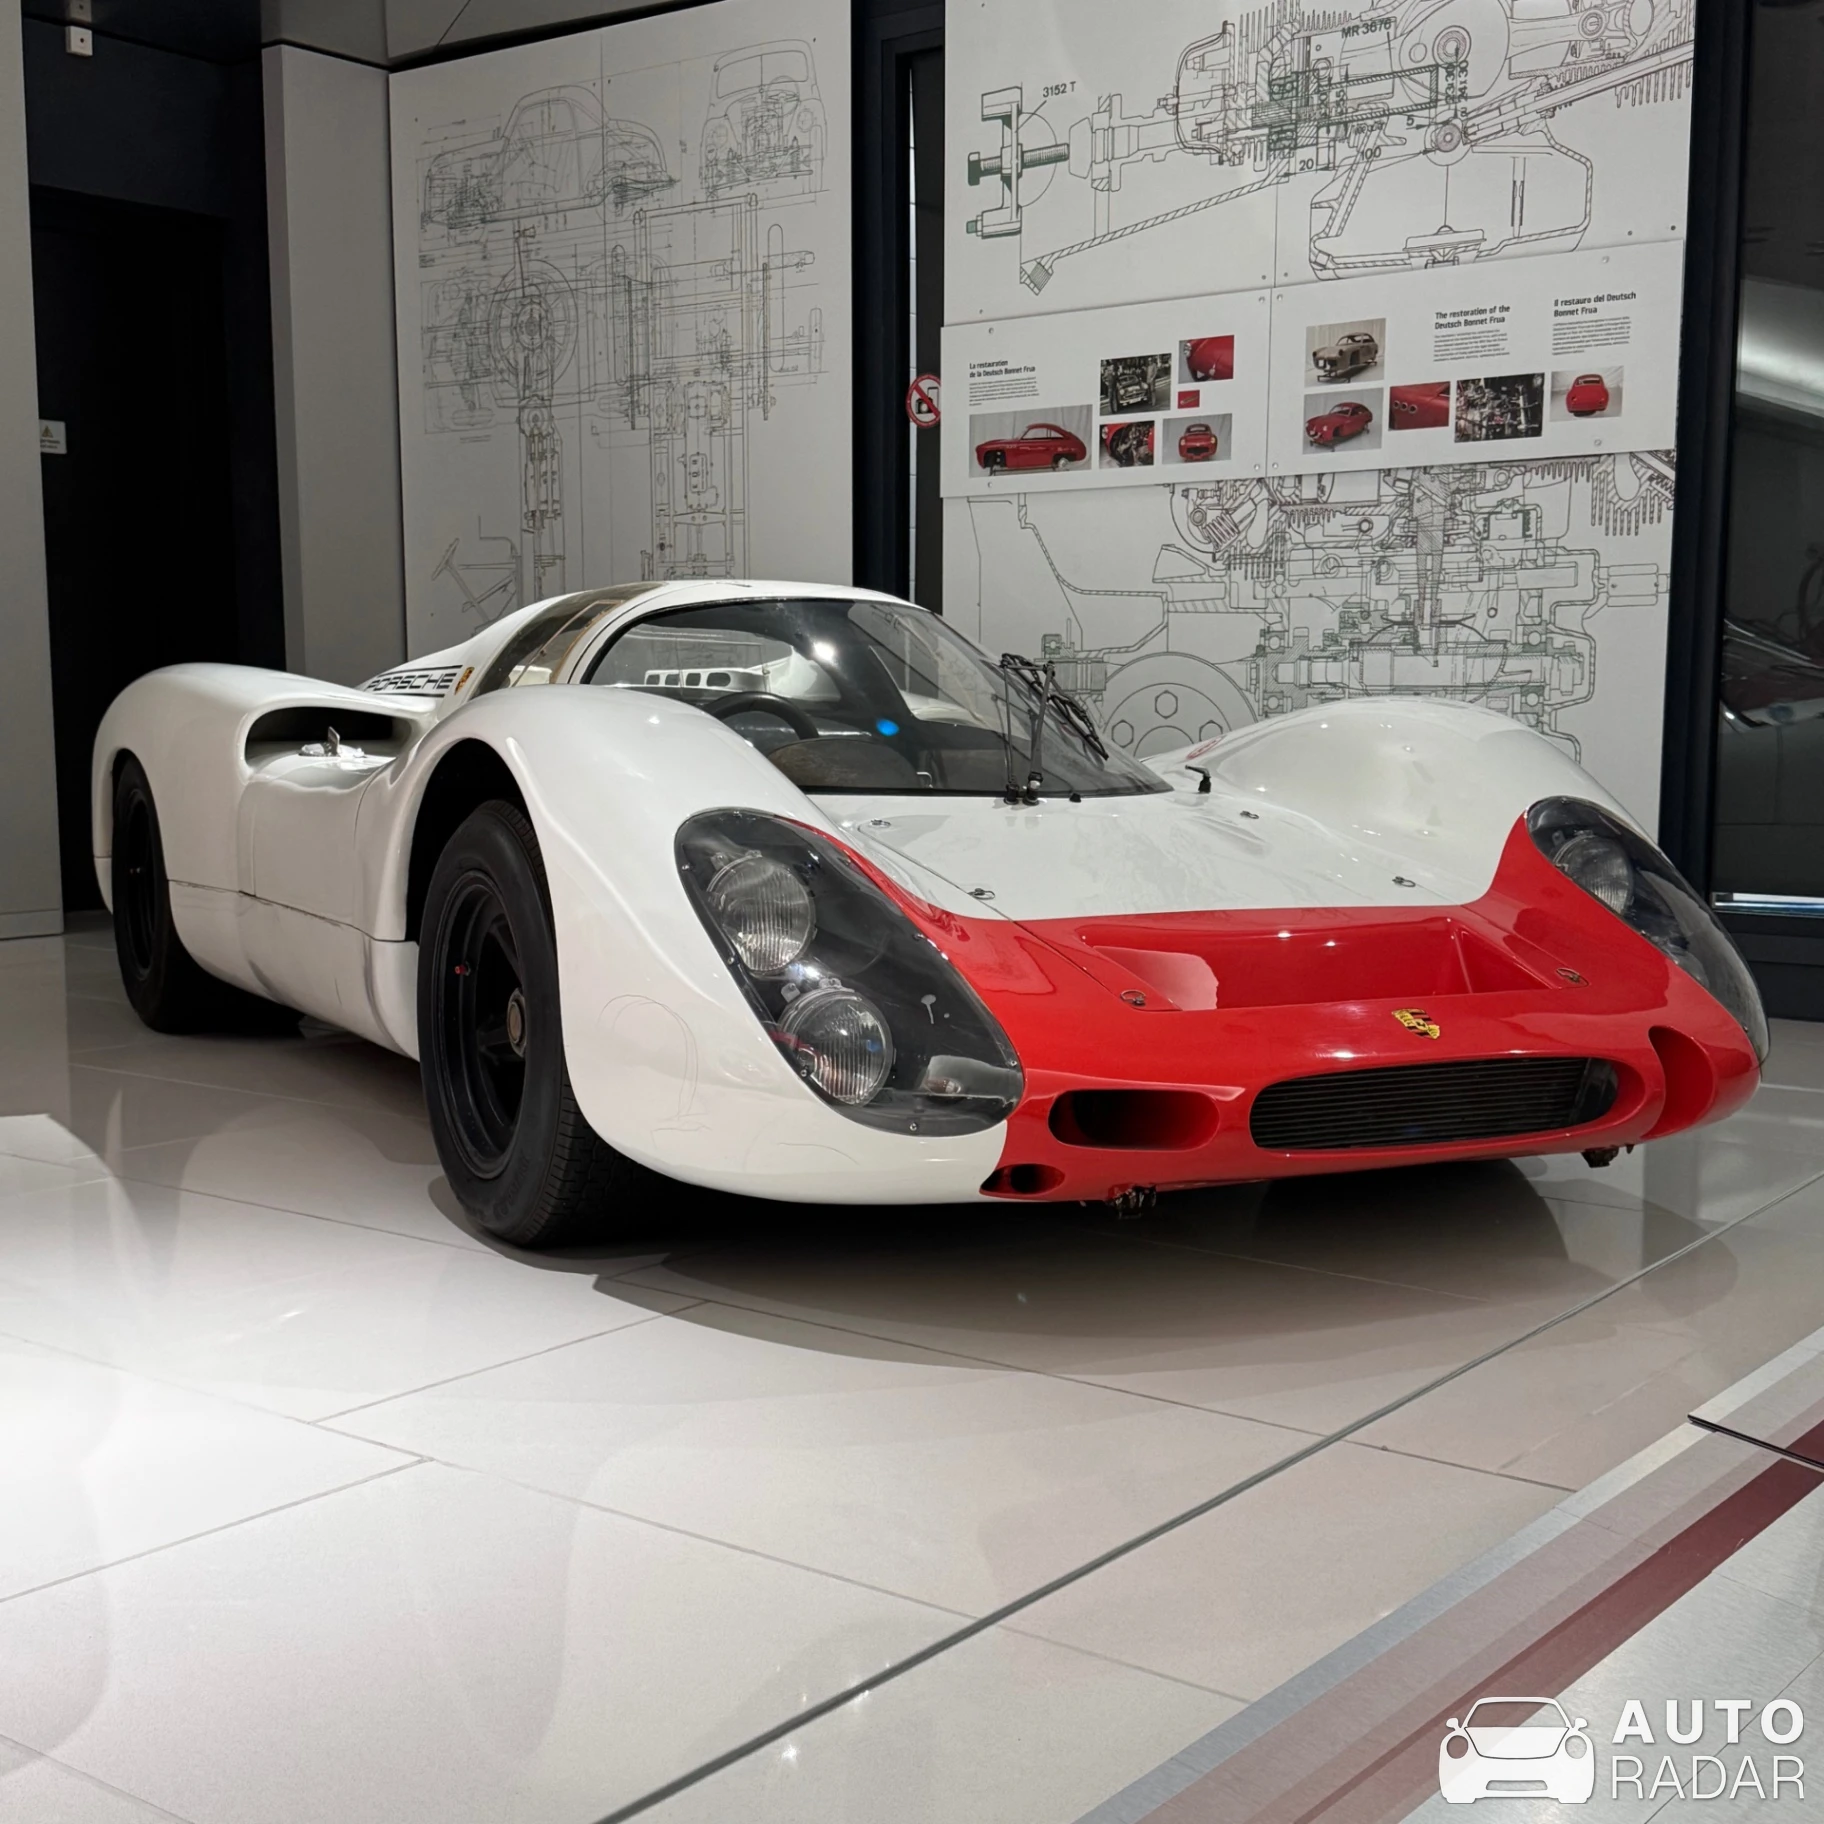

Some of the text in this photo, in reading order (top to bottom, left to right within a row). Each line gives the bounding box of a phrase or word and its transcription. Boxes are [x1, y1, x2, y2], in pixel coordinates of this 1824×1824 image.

[1341, 25, 1359, 39] MR
[1043, 81, 1076, 98] 3152 T
[1406, 115, 1415, 127] 5
[1299, 158, 1314, 171] 20
[1560, 297, 1592, 306] restauro
[1594, 294, 1605, 303] del
[1606, 291, 1636, 302] Deutsch
[1435, 305, 1511, 320] The restoration of the
[1553, 306, 1598, 318] Bonnet Frua
[1434, 315, 1506, 330] Deutsch Bonnet Frua
[977, 360, 1008, 368] restauration
[364, 672, 458, 692] PORSCHE
